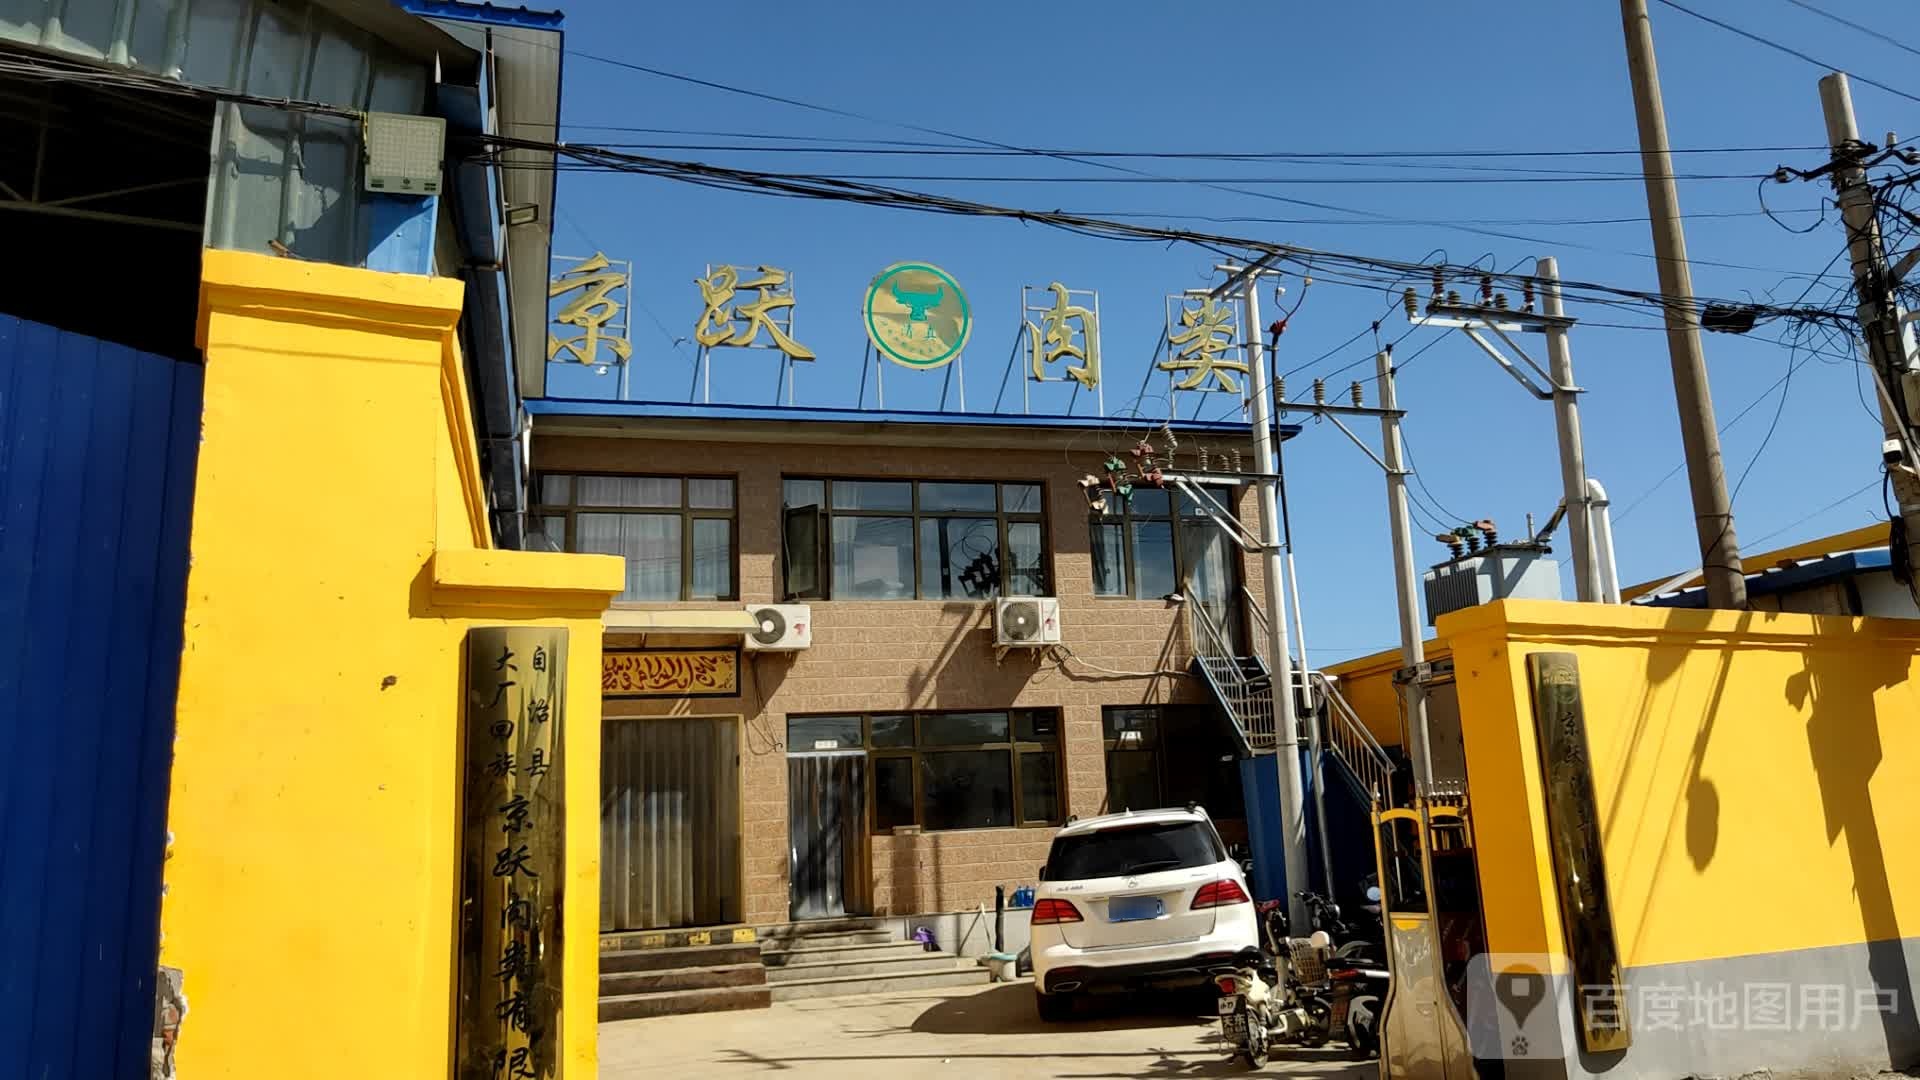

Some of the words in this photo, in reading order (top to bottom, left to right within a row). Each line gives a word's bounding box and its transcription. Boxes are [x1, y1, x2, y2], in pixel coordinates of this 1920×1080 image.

[548, 251, 816, 365] 京跃
[487, 645, 519, 777] 大厂回族
[524, 645, 551, 777] 自治县
[491, 794, 539, 1080] 京跃肉类有限
